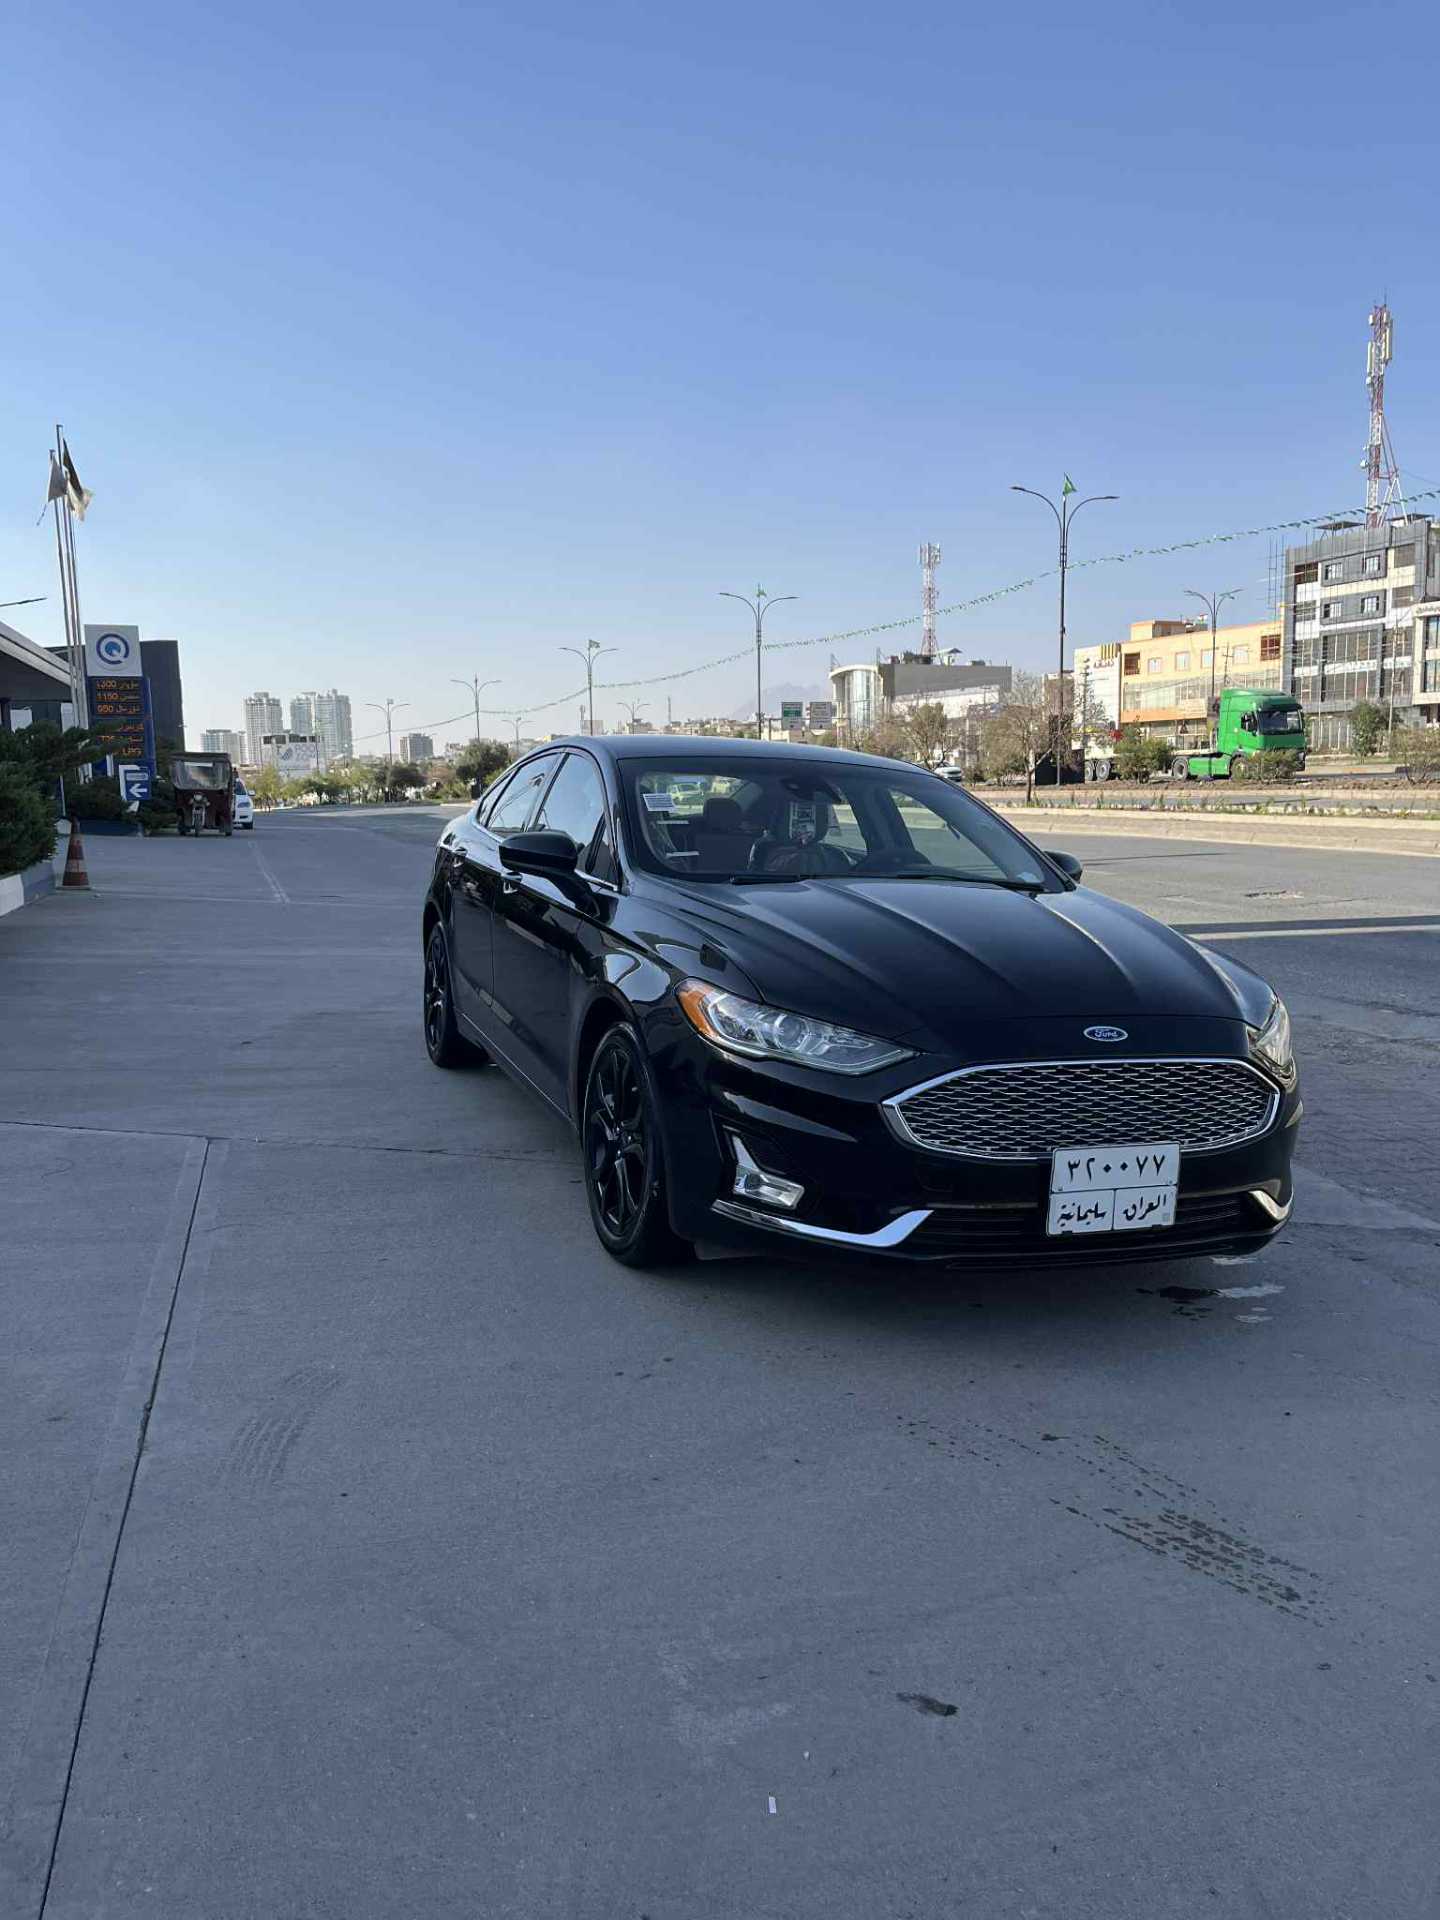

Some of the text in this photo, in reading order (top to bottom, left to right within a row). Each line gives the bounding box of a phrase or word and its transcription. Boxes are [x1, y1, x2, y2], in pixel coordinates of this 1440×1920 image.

[1094, 1027, 1119, 1038] Ford
[1067, 1154, 1166, 1183] ٣٢٠٠٧٧
[1122, 1193, 1167, 1222] العراق
